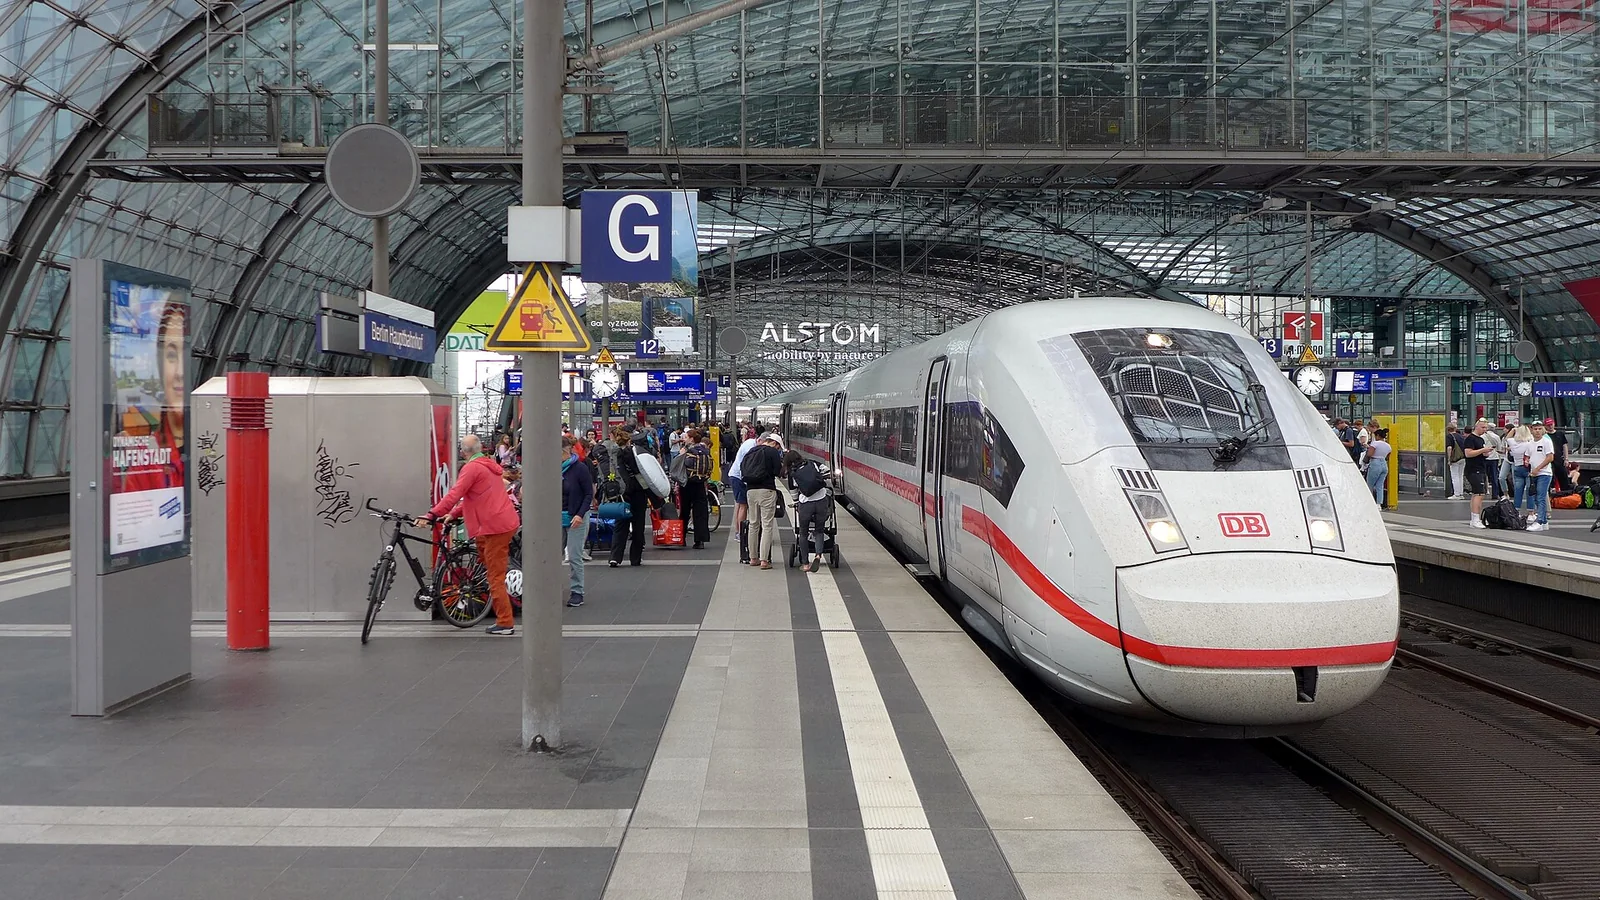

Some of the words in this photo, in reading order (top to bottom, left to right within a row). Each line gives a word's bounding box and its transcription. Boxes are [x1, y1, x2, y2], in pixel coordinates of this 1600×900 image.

[608, 194, 659, 262] G
[371, 321, 388, 342] Berlin
[389, 326, 424, 350] Hauptbahnhof
[760, 321, 880, 345] ALSTOM
[447, 335, 486, 350] DAT
[640, 339, 657, 354] 12
[1260, 339, 1277, 353] 13
[1341, 339, 1356, 353] 14
[763, 350, 815, 361] mobility
[817, 350, 832, 361] by
[1488, 360, 1500, 370] 15
[722, 375, 729, 385] F
[113, 447, 172, 468] HAFENSTADT
[1224, 516, 1264, 533] DB
